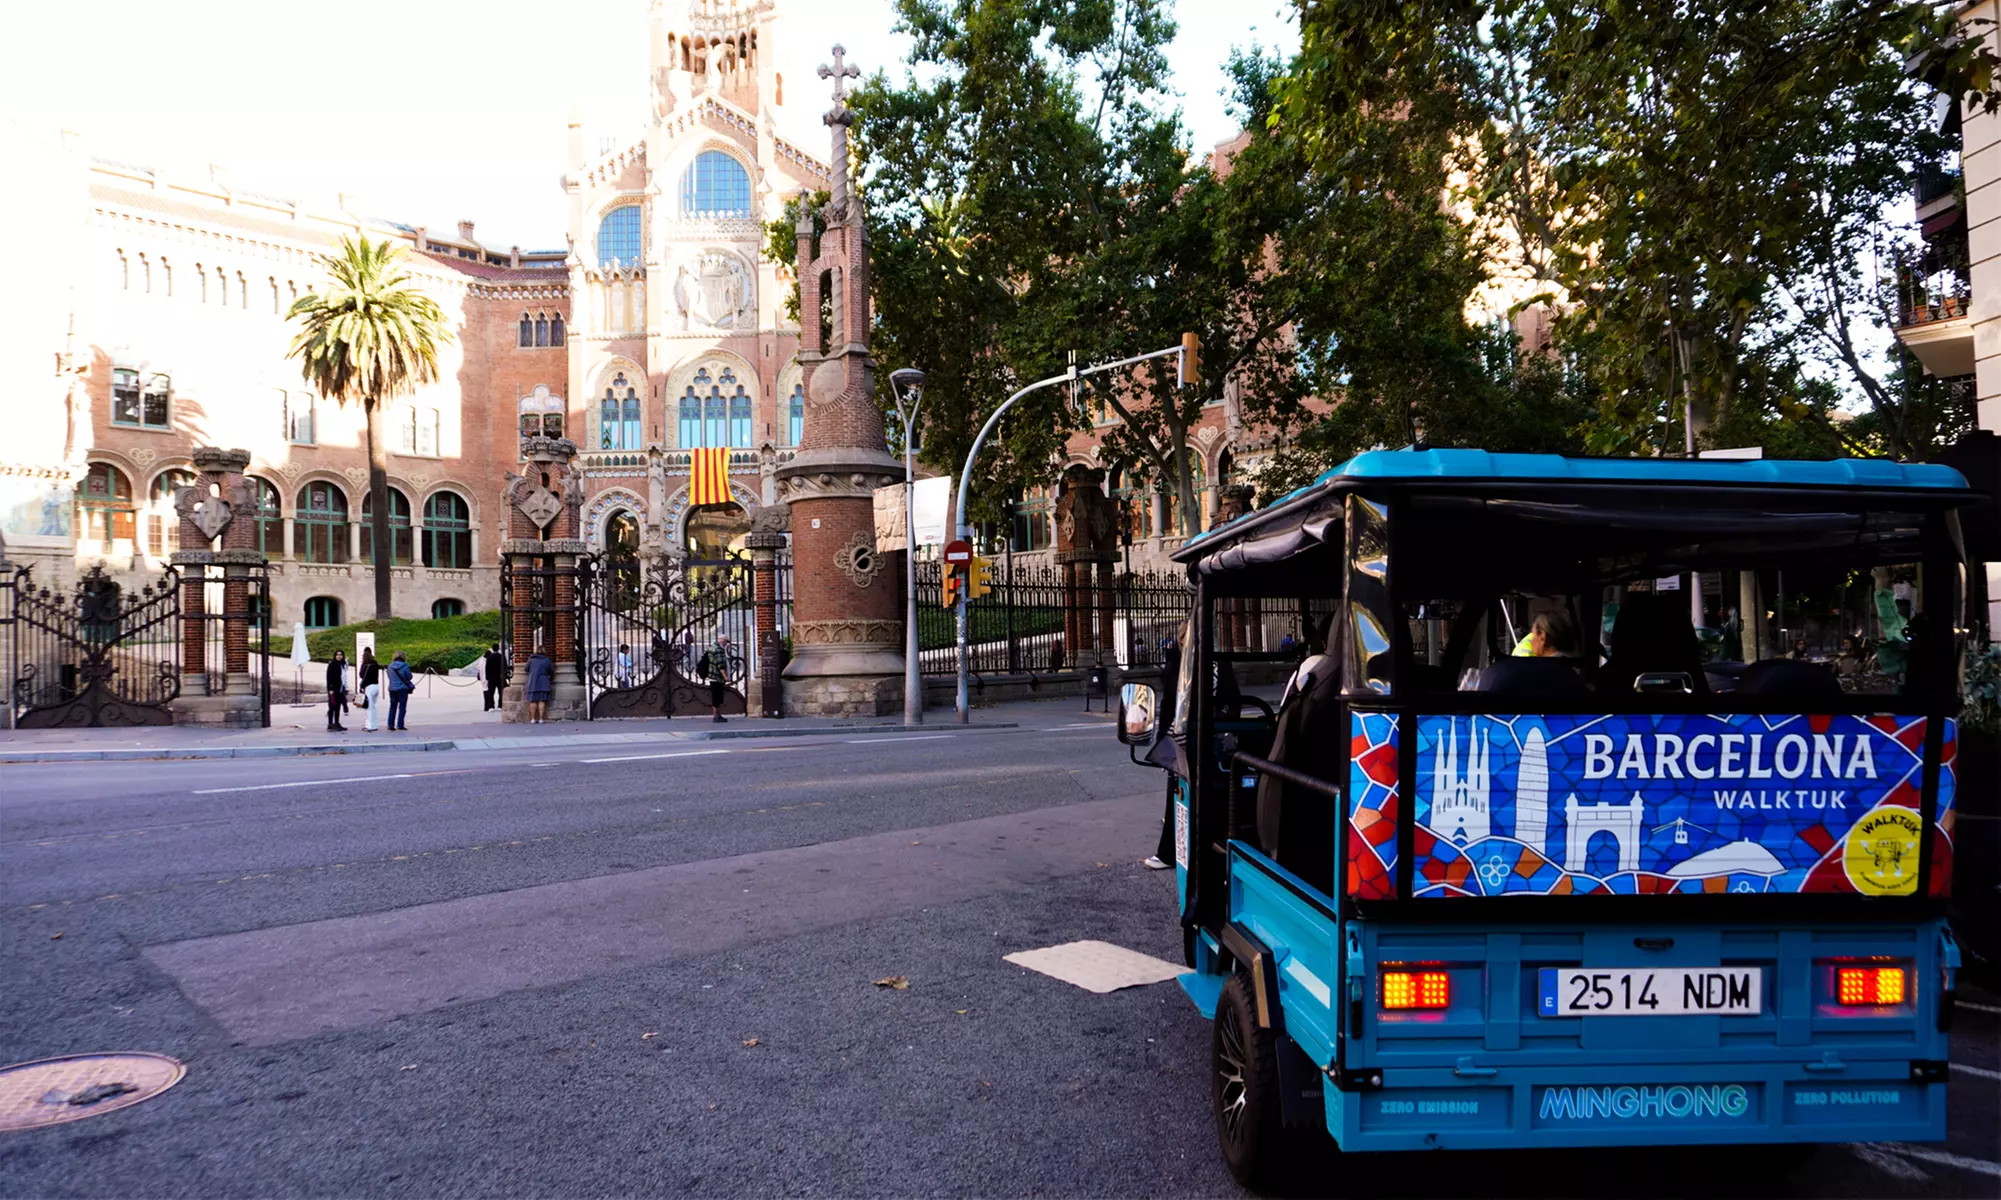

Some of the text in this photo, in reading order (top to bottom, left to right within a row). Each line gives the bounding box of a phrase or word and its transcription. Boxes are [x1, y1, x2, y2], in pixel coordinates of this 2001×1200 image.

[1583, 733, 1879, 780] BARCELONA
[1713, 789, 1847, 810] WALKTUK
[1861, 813, 1921, 837] WALKTUK
[1544, 973, 1751, 1011] E 2514 NDM
[1380, 1100, 1479, 1115] ZERO EMISSION
[1539, 1084, 1748, 1119] MINGHONG
[1794, 1089, 1900, 1106] ZERO POLLUTION
